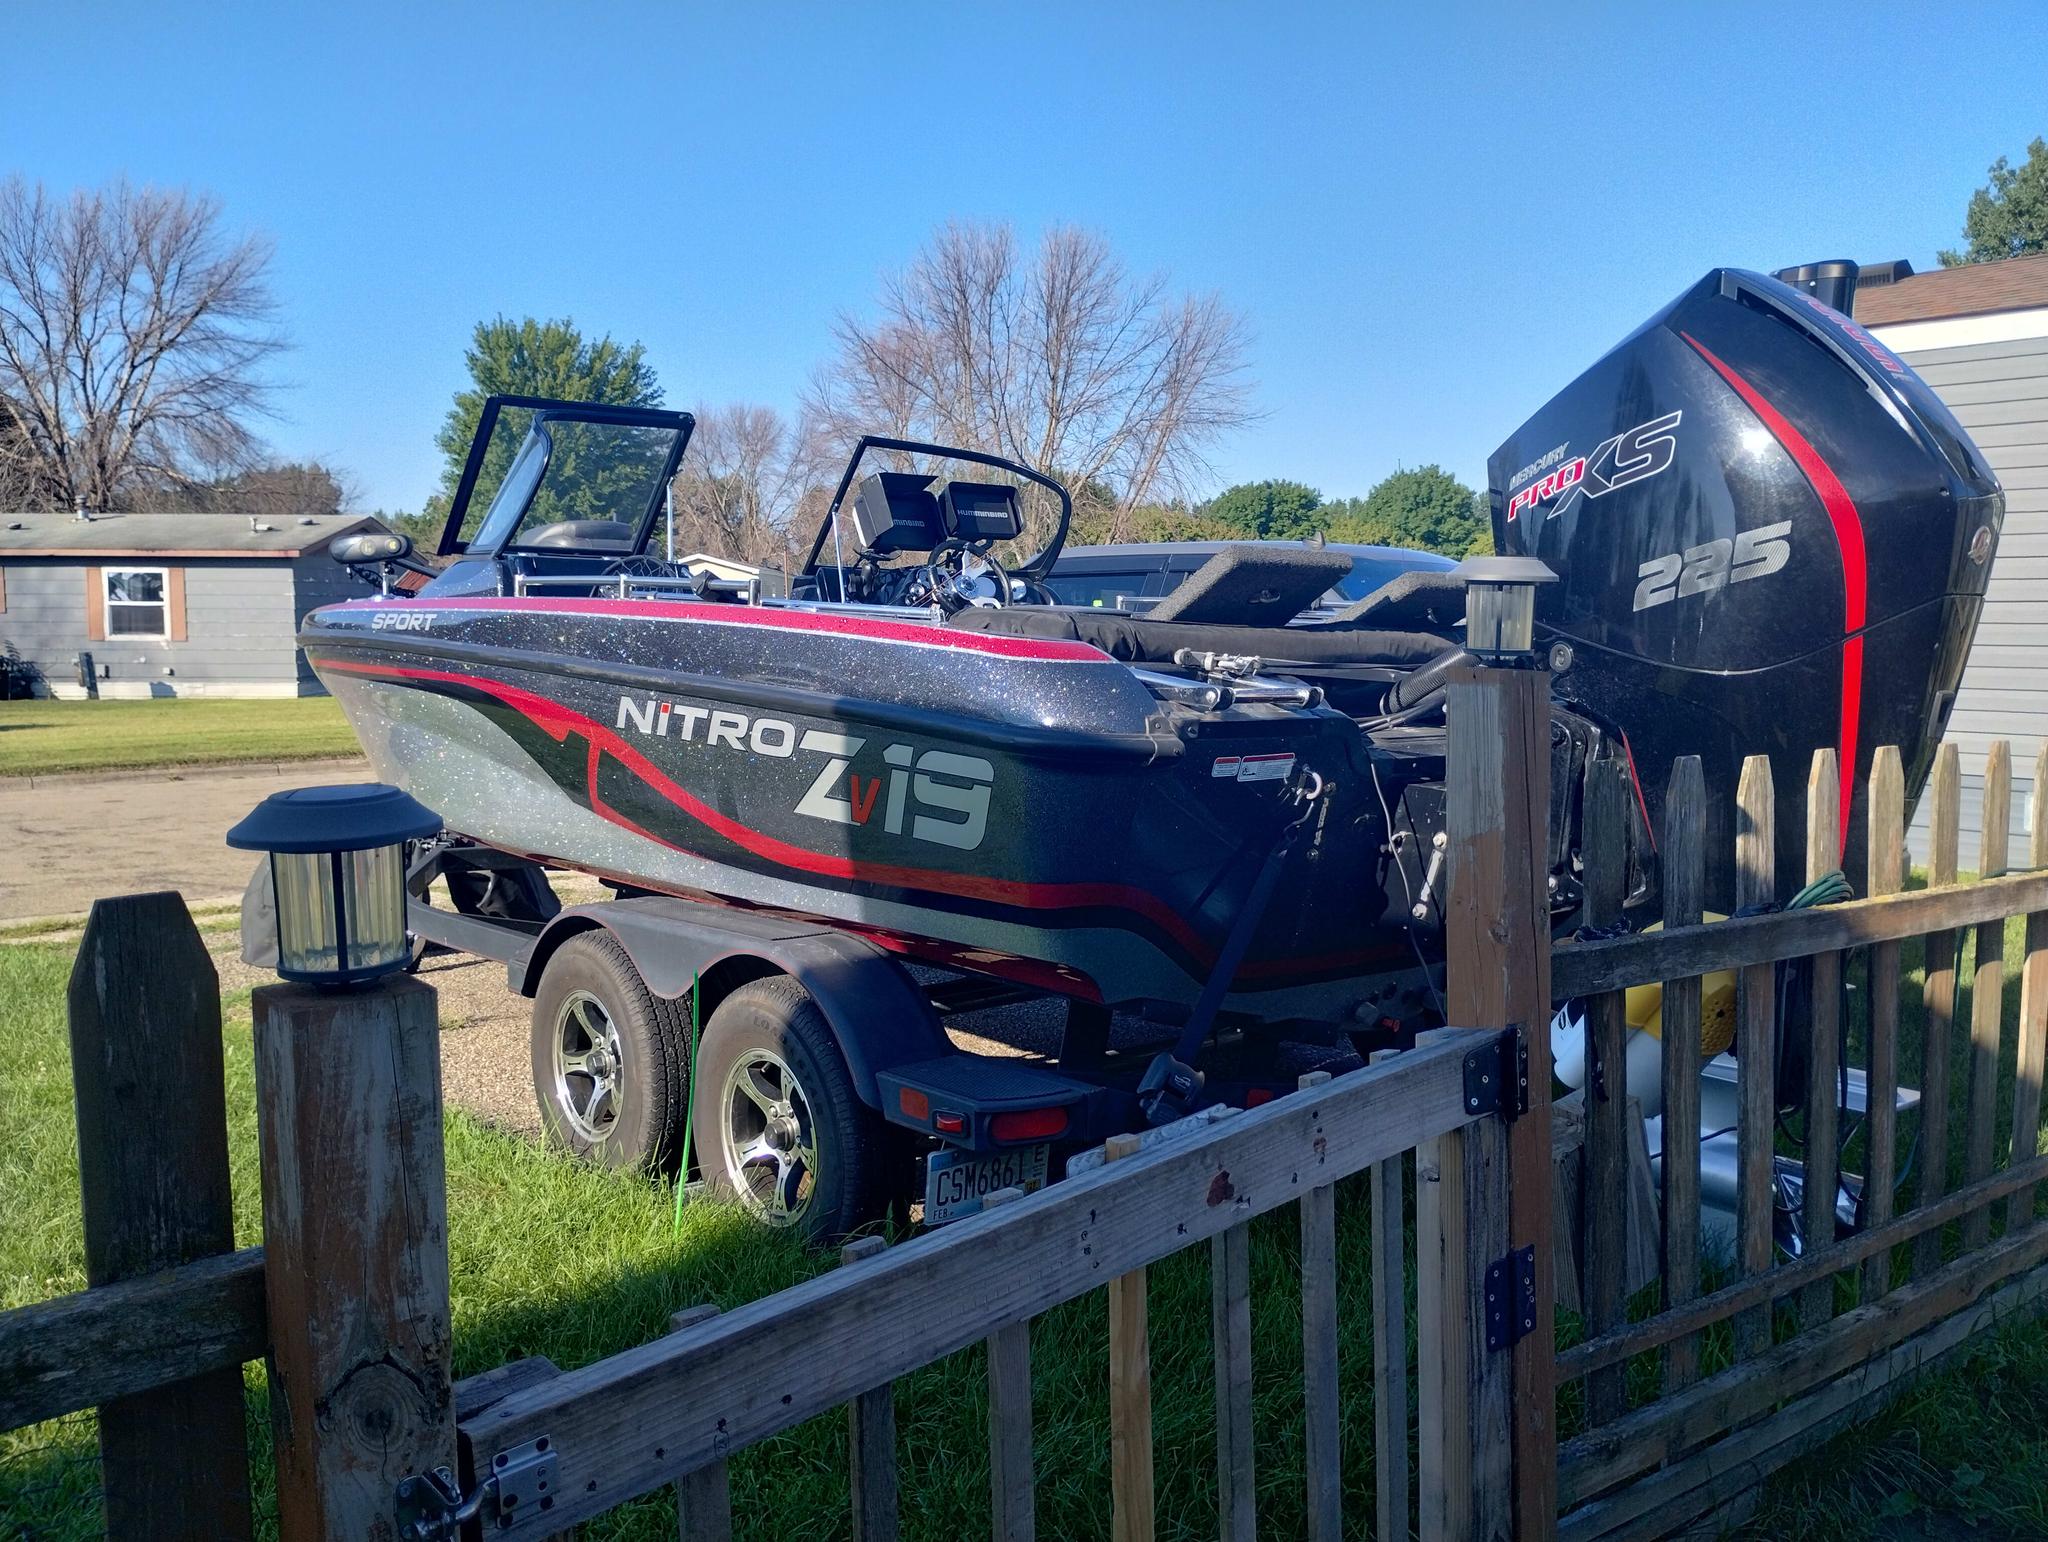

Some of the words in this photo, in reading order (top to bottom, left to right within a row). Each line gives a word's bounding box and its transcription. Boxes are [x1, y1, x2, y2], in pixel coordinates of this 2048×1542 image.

[1507, 457, 1586, 523] PRO
[1547, 409, 1682, 520] XS
[1509, 441, 1570, 491] MERCURY
[957, 509, 1009, 519] HUMMINBIRD
[1632, 519, 1793, 613] 225
[371, 612, 438, 632] SPORT
[936, 1151, 1026, 1207] CSM6861
[933, 1208, 948, 1220] FEB
